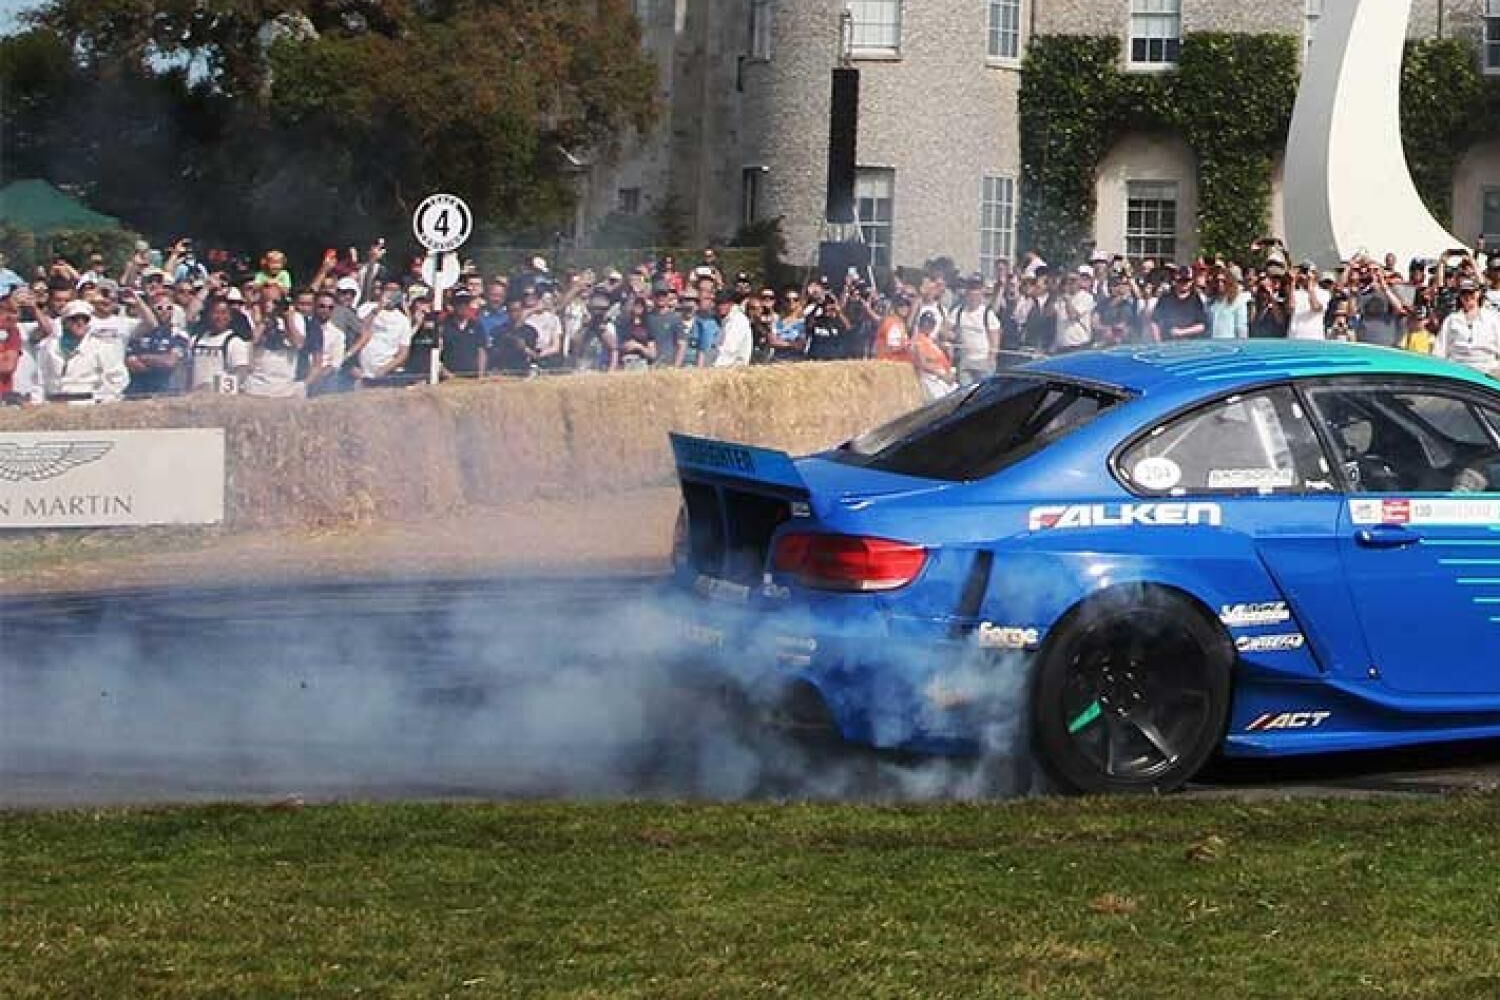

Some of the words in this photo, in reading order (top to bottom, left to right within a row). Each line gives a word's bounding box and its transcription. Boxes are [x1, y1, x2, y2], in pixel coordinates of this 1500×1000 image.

[434, 209, 450, 236] 4
[23, 495, 131, 516] MARTIN
[1028, 502, 1223, 531] FALKEN
